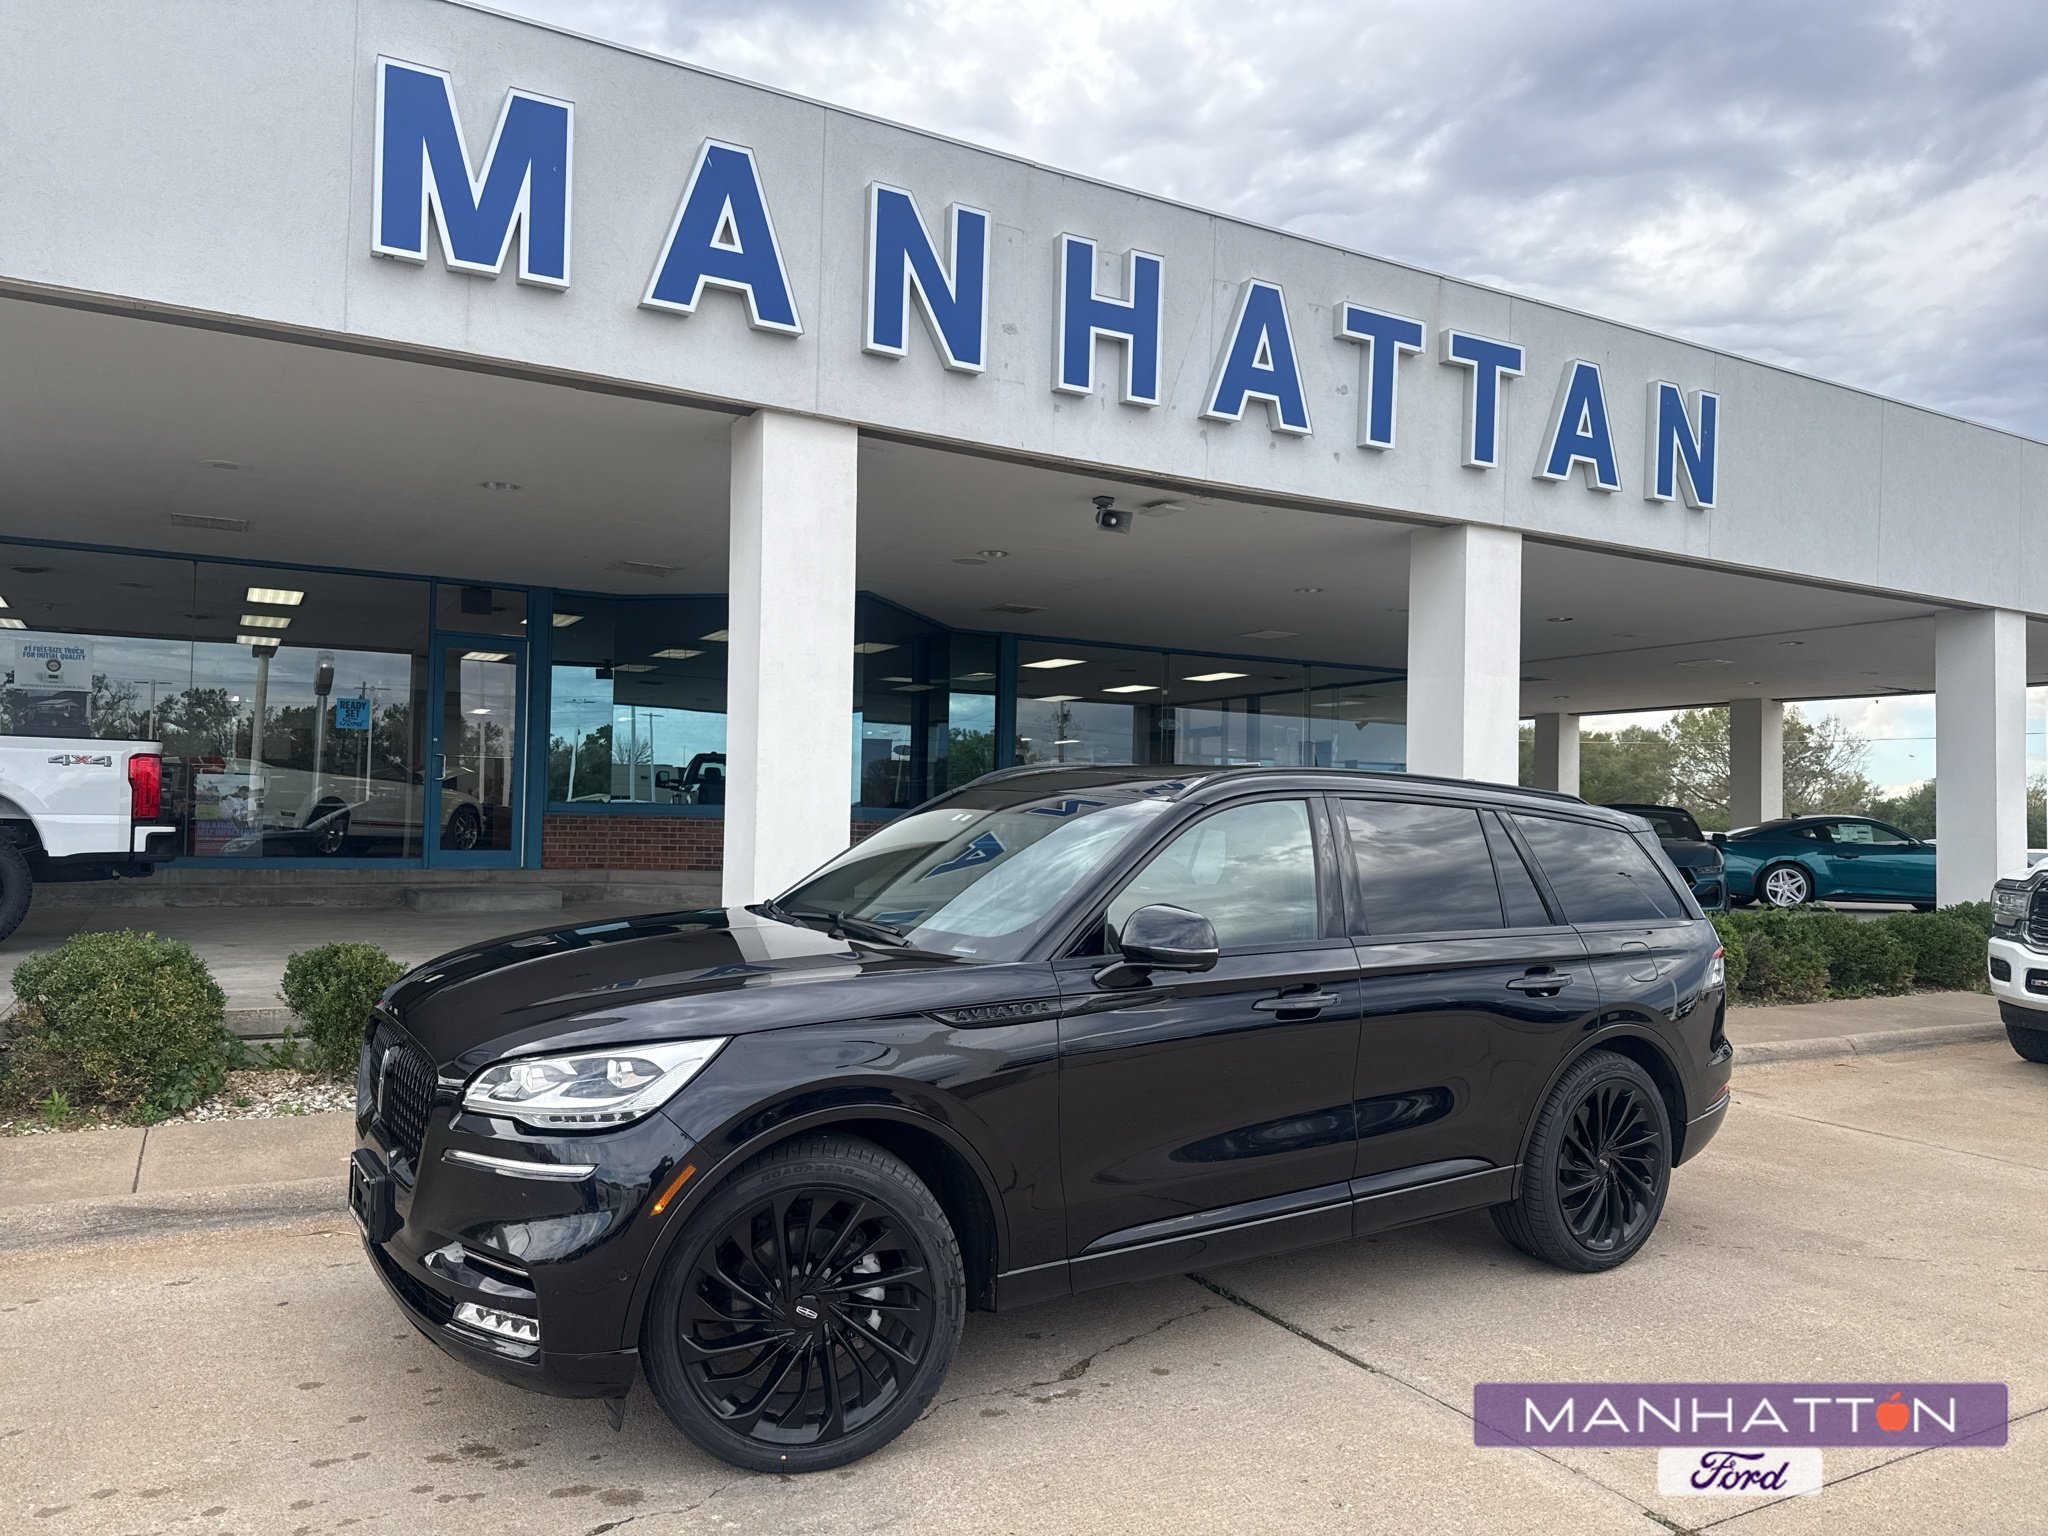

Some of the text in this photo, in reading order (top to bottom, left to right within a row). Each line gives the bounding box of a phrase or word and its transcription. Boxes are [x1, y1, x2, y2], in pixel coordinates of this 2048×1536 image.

[371, 54, 1720, 510] MANHATTAN
[33, 646, 63, 654] FULL-SIZE
[64, 647, 85, 655] TRUCK
[36, 652, 59, 660] INITIAL
[340, 701, 367, 710] READY
[345, 710, 360, 718] SET
[340, 717, 363, 727] Ford
[955, 1002, 1050, 1021] AVIATOR
